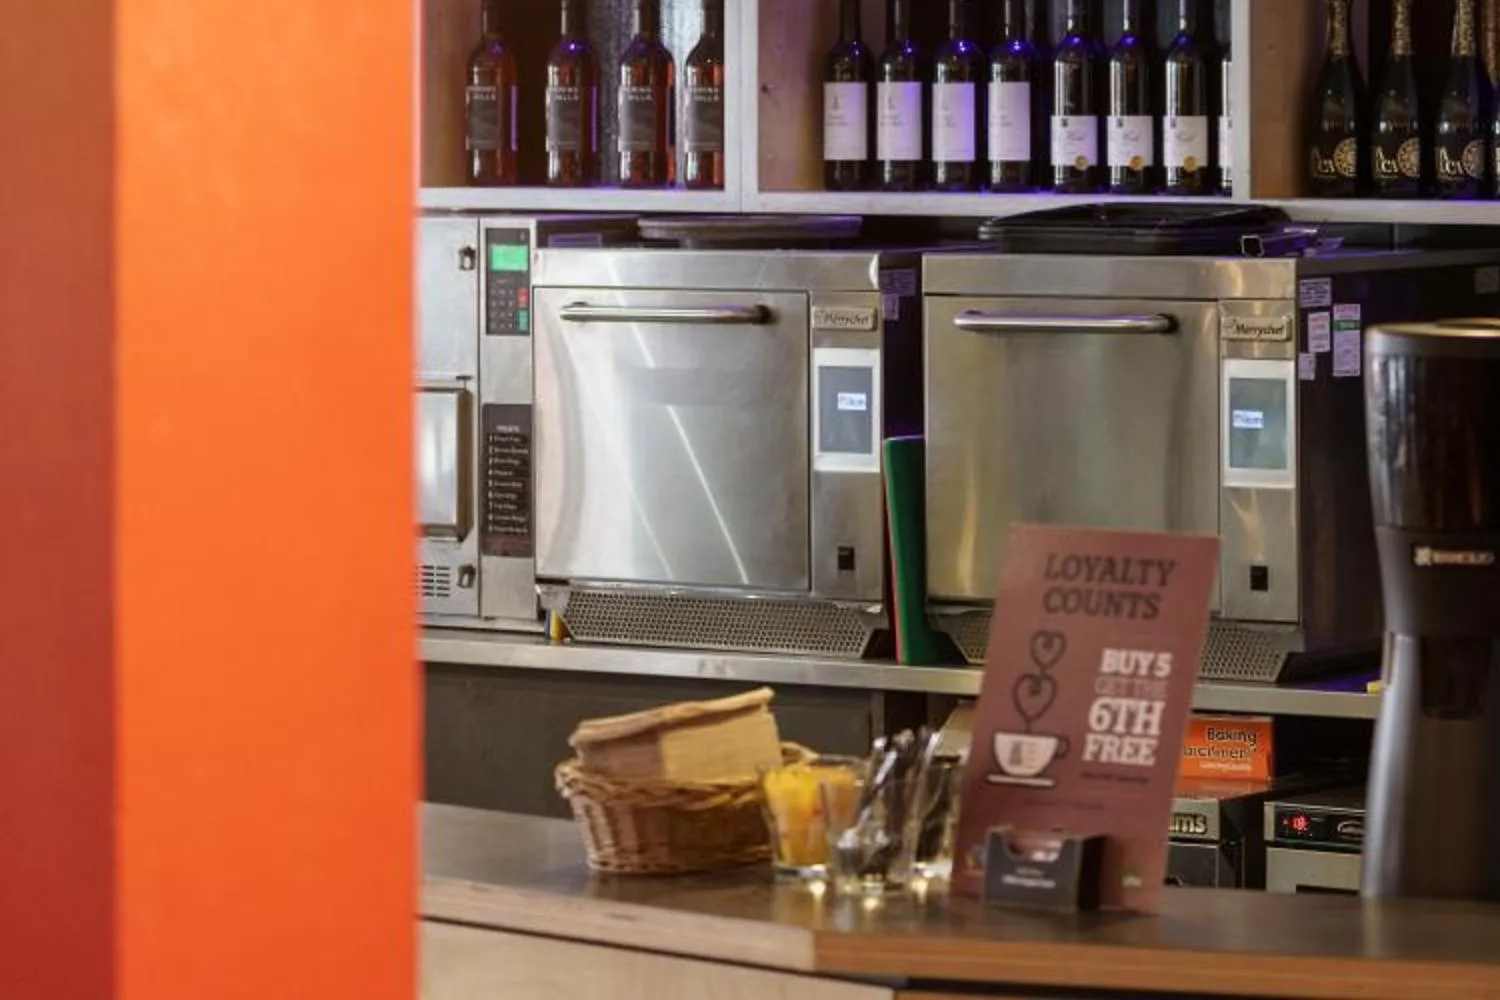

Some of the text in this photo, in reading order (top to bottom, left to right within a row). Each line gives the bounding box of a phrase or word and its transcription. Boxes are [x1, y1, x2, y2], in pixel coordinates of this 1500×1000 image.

[1043, 553, 1176, 589] LOYALTY
[1043, 590, 1161, 621] COUNTS
[1101, 647, 1172, 678] BUY 5
[1094, 676, 1168, 700] GET THE
[1088, 699, 1165, 736] 6TH
[1082, 733, 1158, 767] FREE
[1207, 727, 1257, 748] Baking
